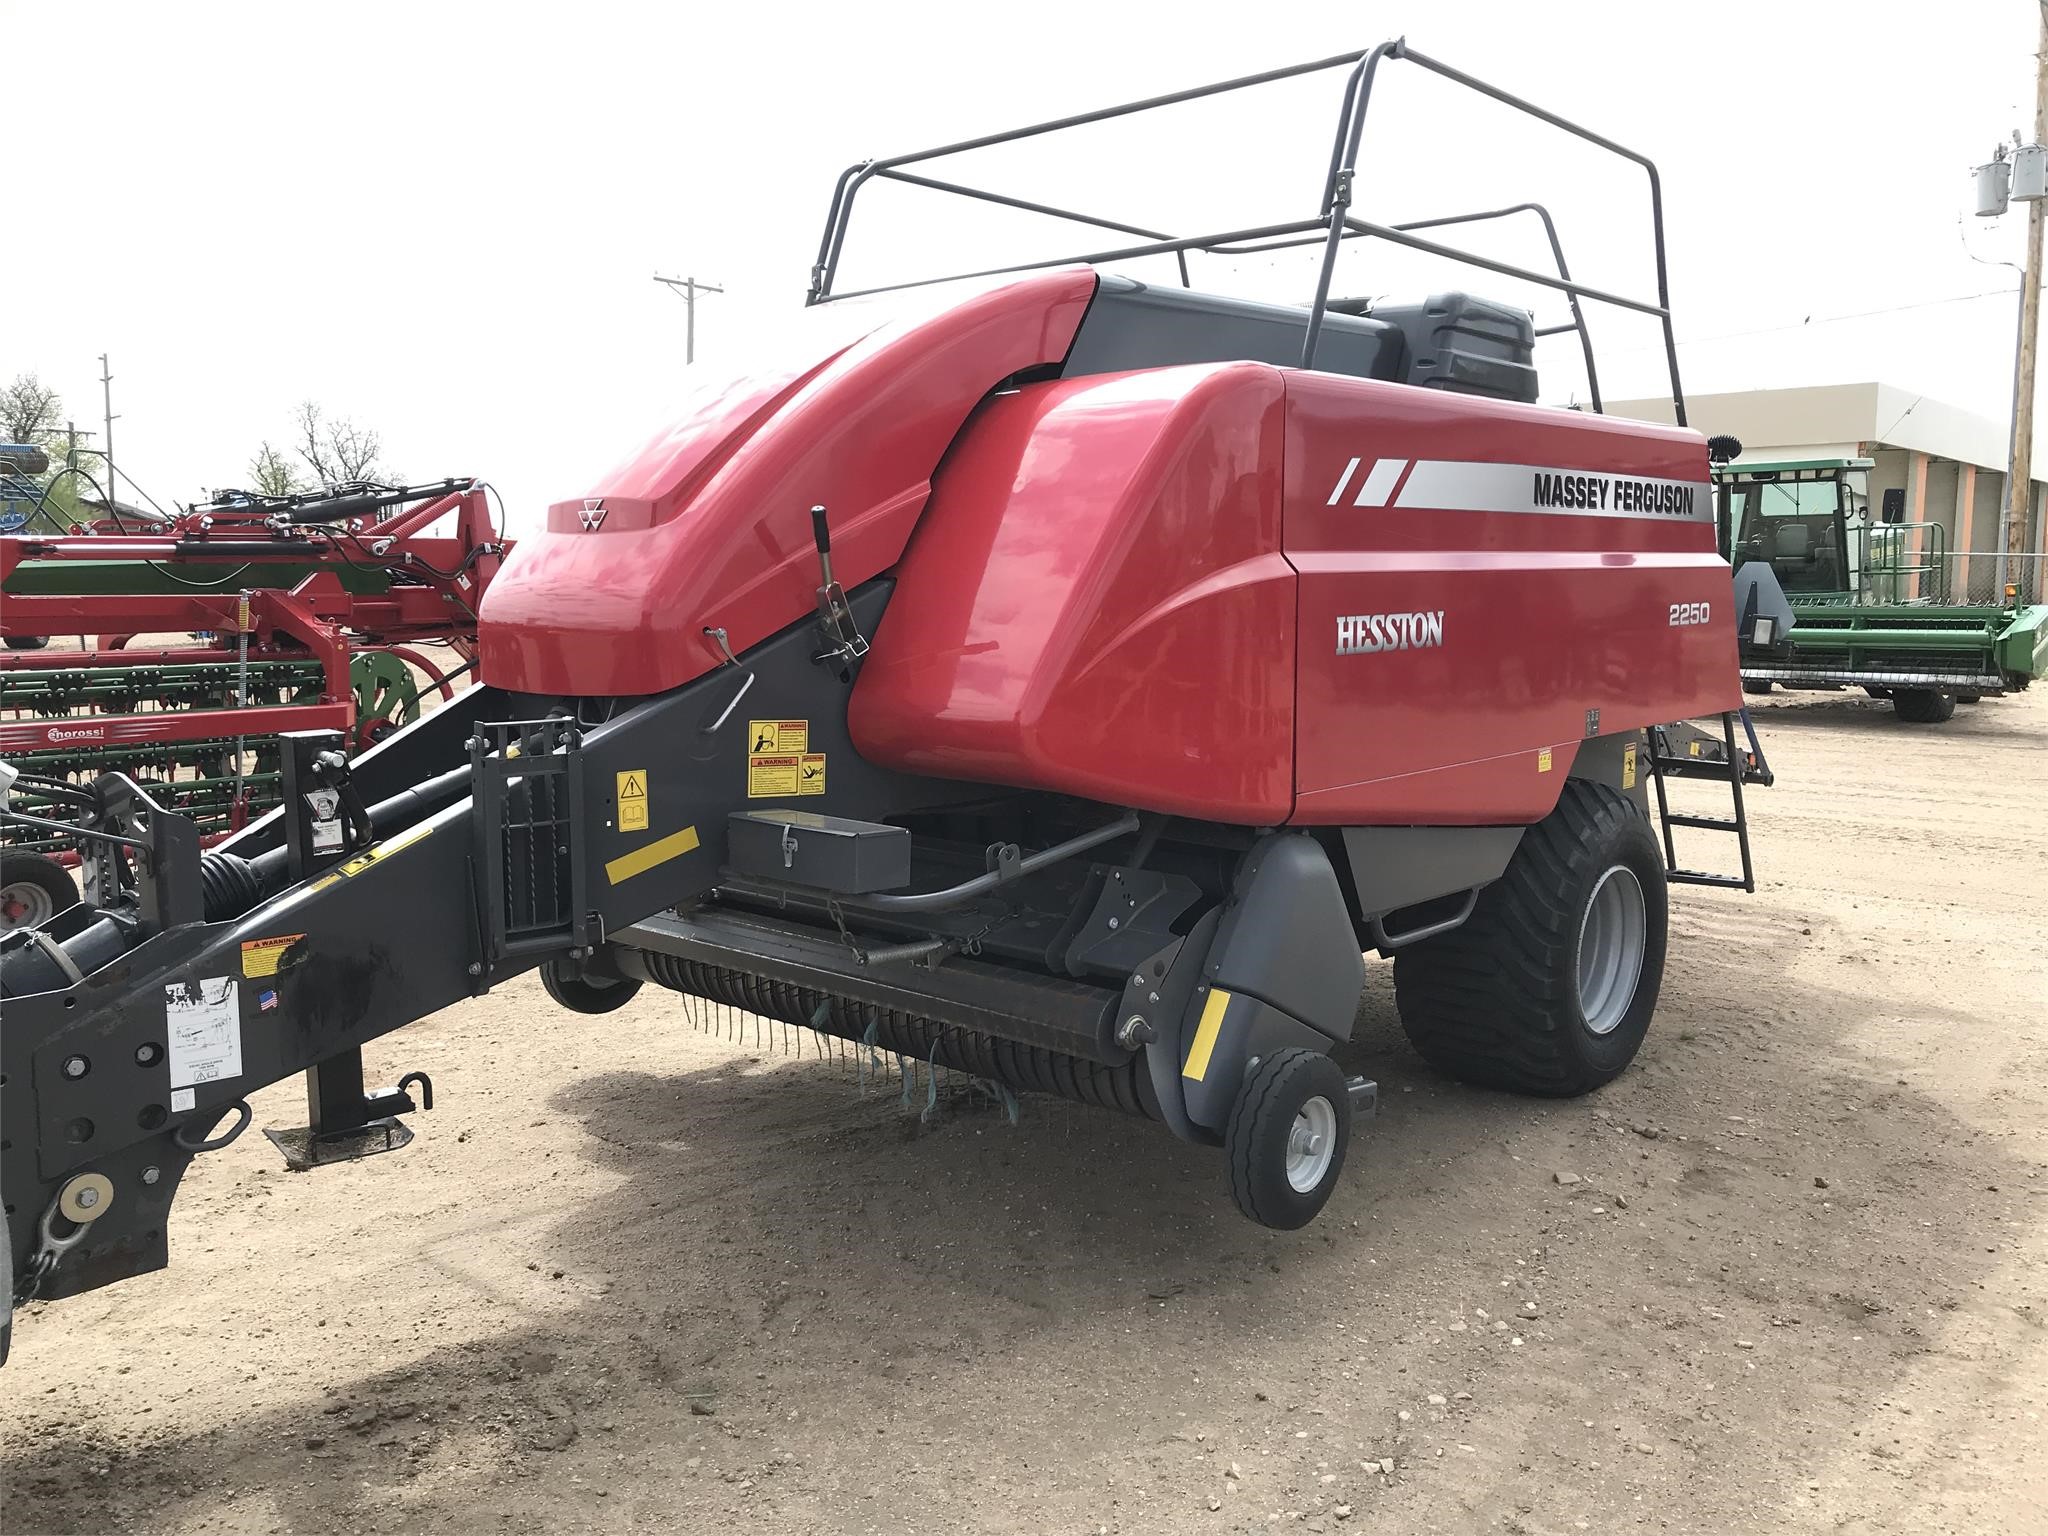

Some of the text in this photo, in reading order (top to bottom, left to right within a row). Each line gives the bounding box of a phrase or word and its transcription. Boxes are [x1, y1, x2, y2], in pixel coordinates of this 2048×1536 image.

[1533, 473, 1694, 516] MASSEY FERGUSON
[1669, 602, 1710, 626] 2250
[1336, 611, 1444, 655] HESSTON
[48, 727, 104, 741] enorossi
[261, 937, 296, 946] WARNING
